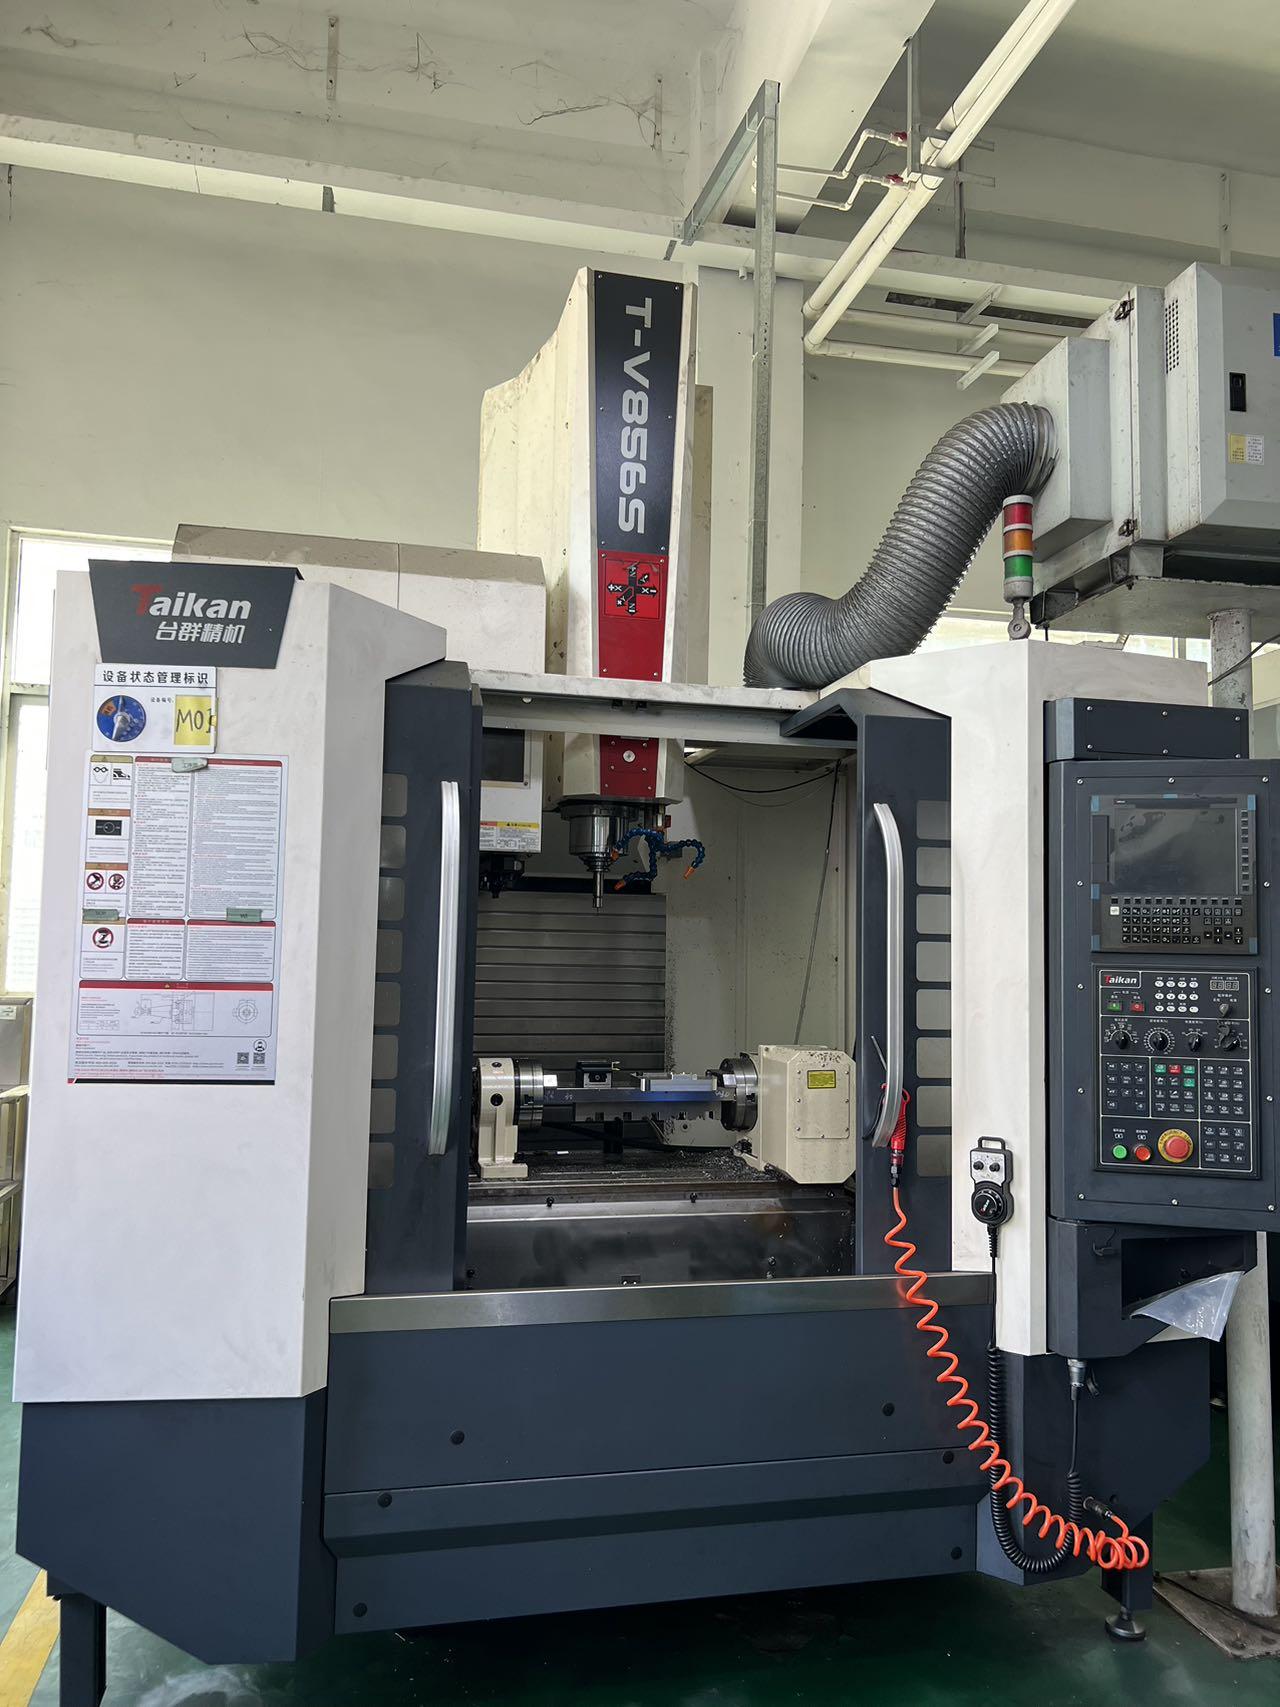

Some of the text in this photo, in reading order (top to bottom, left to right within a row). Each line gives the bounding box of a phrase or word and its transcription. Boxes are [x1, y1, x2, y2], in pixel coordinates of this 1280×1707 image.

[617, 298, 653, 535] T-V856S
[130, 583, 252, 620] Taikan
[154, 621, 246, 645] 台群精机
[102, 669, 209, 686] 设备状态管理标识
[1104, 975, 1137, 985] Taikan
